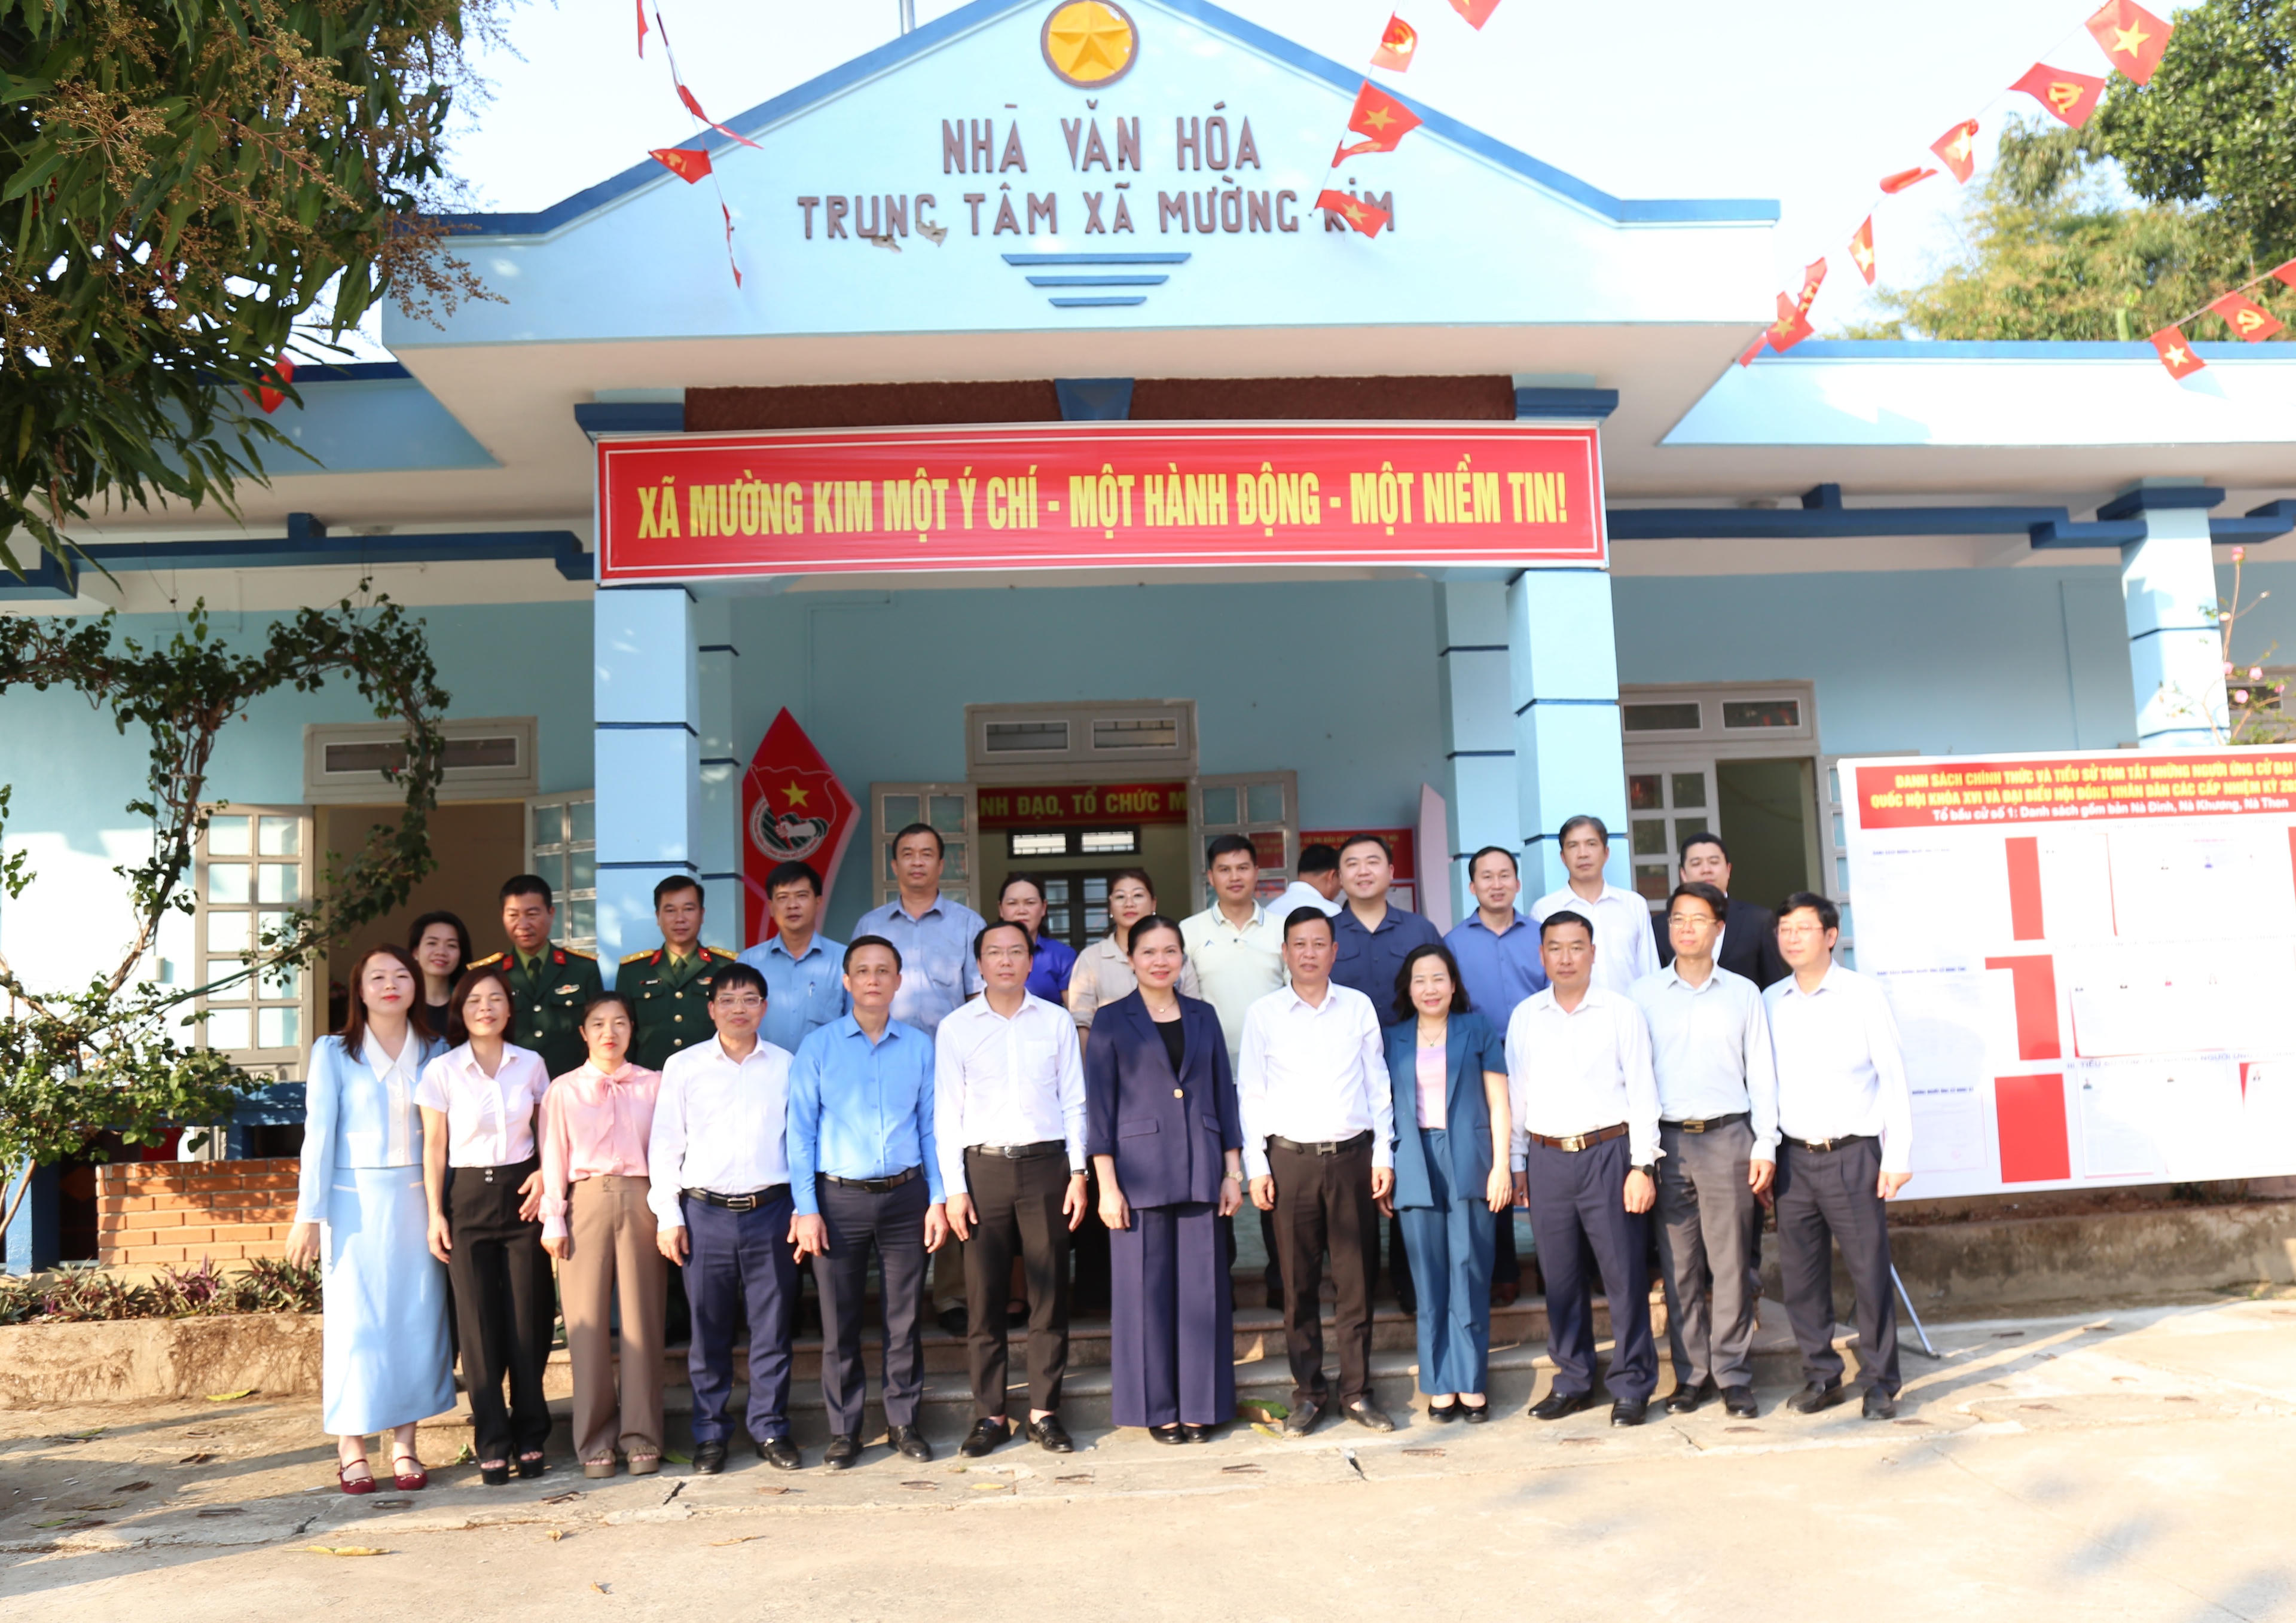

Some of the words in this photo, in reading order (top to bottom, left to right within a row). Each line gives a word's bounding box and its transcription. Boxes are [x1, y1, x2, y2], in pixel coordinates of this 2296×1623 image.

[1060, 99, 1140, 172] VĂN
[1177, 100, 1261, 172] HÓA
[964, 182, 1057, 236] TÂM
[1083, 182, 1134, 234] XÃ
[1158, 175, 1299, 233] MƯỜNG
[637, 475, 680, 539] XÃ
[689, 469, 804, 537] MƯỜNG
[813, 480, 873, 533] KIM
[883, 467, 949, 542] MỘT
[958, 466, 977, 530] Ý
[987, 464, 1039, 530] CHÍ
[1069, 463, 1135, 539] MỘT
[1144, 462, 1229, 527] HÀNH
[1236, 461, 1321, 537] ĐỘNG
[1349, 460, 1414, 536] MỘT
[1423, 454, 1502, 524] NIỀM
[1507, 472, 1568, 524] TIN!
[1895, 774, 1929, 788] DANH
[1931, 771, 1963, 787] SÁCH
[1965, 769, 2002, 786] CHÍNH
[2004, 768, 2034, 784] THỨC
[2035, 767, 2052, 783] VÀ
[978, 796, 1009, 817] NH
[1017, 794, 1064, 820] ĐẠO,
[1071, 785, 1098, 814] TỔ
[1105, 788, 1161, 814] CHỨC
[1870, 790, 1903, 809] QUỐC
[1905, 790, 1926, 809] HỘI
[1962, 790, 1983, 805] XVI
[1984, 788, 2001, 805] VÀ
[2020, 805, 2049, 818] Danh
